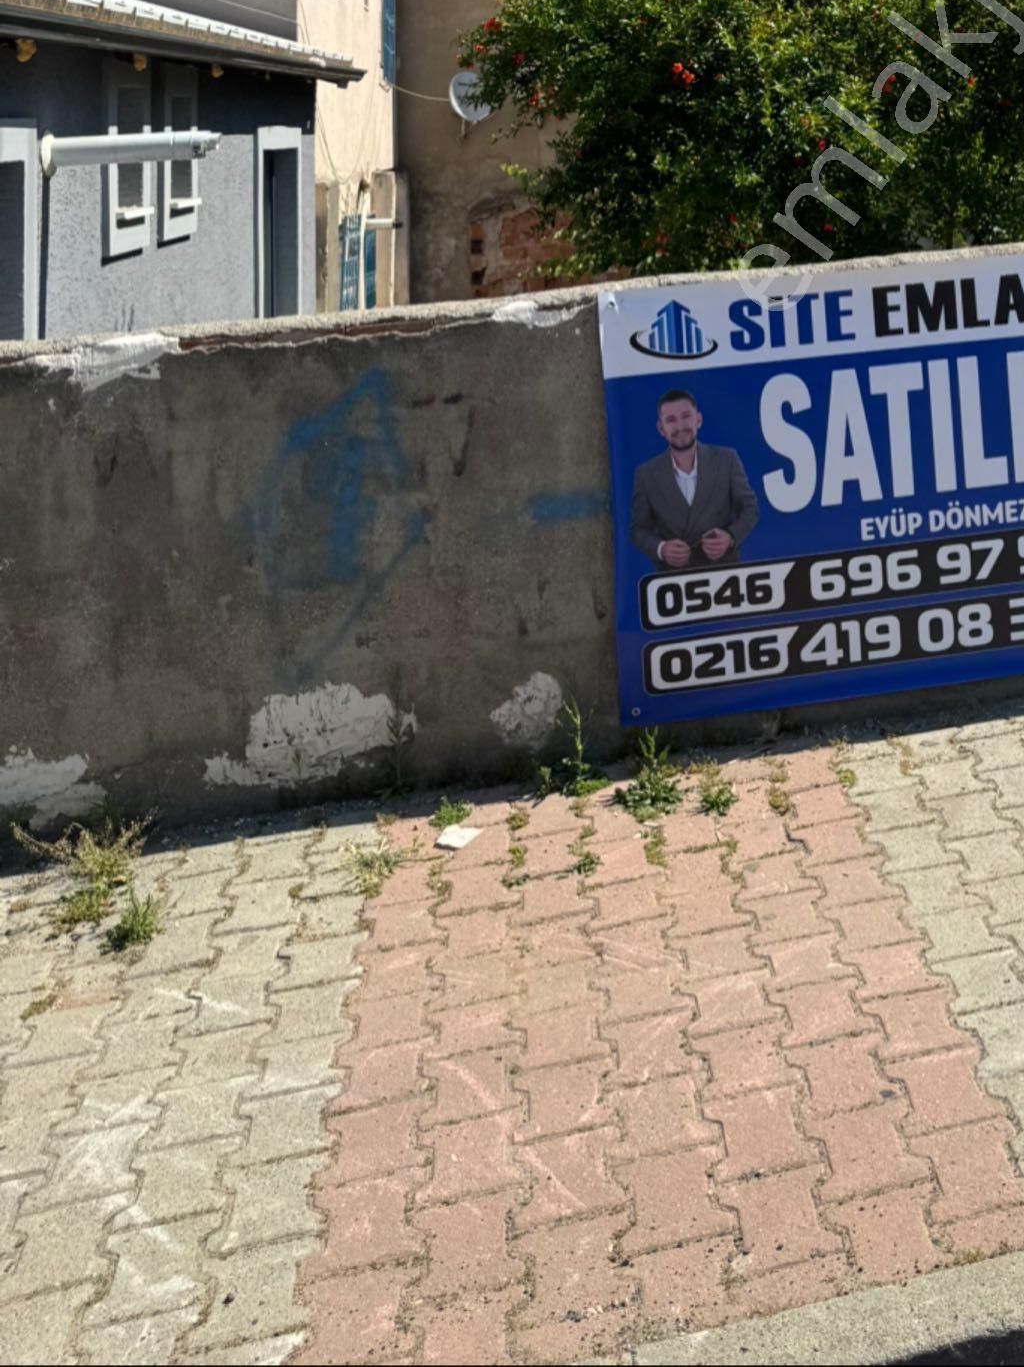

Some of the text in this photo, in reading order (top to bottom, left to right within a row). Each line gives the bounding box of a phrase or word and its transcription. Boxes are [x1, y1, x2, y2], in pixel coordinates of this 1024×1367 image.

[860, 507, 923, 542] EYÜP
[655, 572, 774, 618] 0546
[809, 549, 922, 602] 696
[936, 538, 1005, 584] 97
[659, 635, 782, 684] 0216
[799, 616, 901, 667] 419
[917, 603, 994, 653] 08
